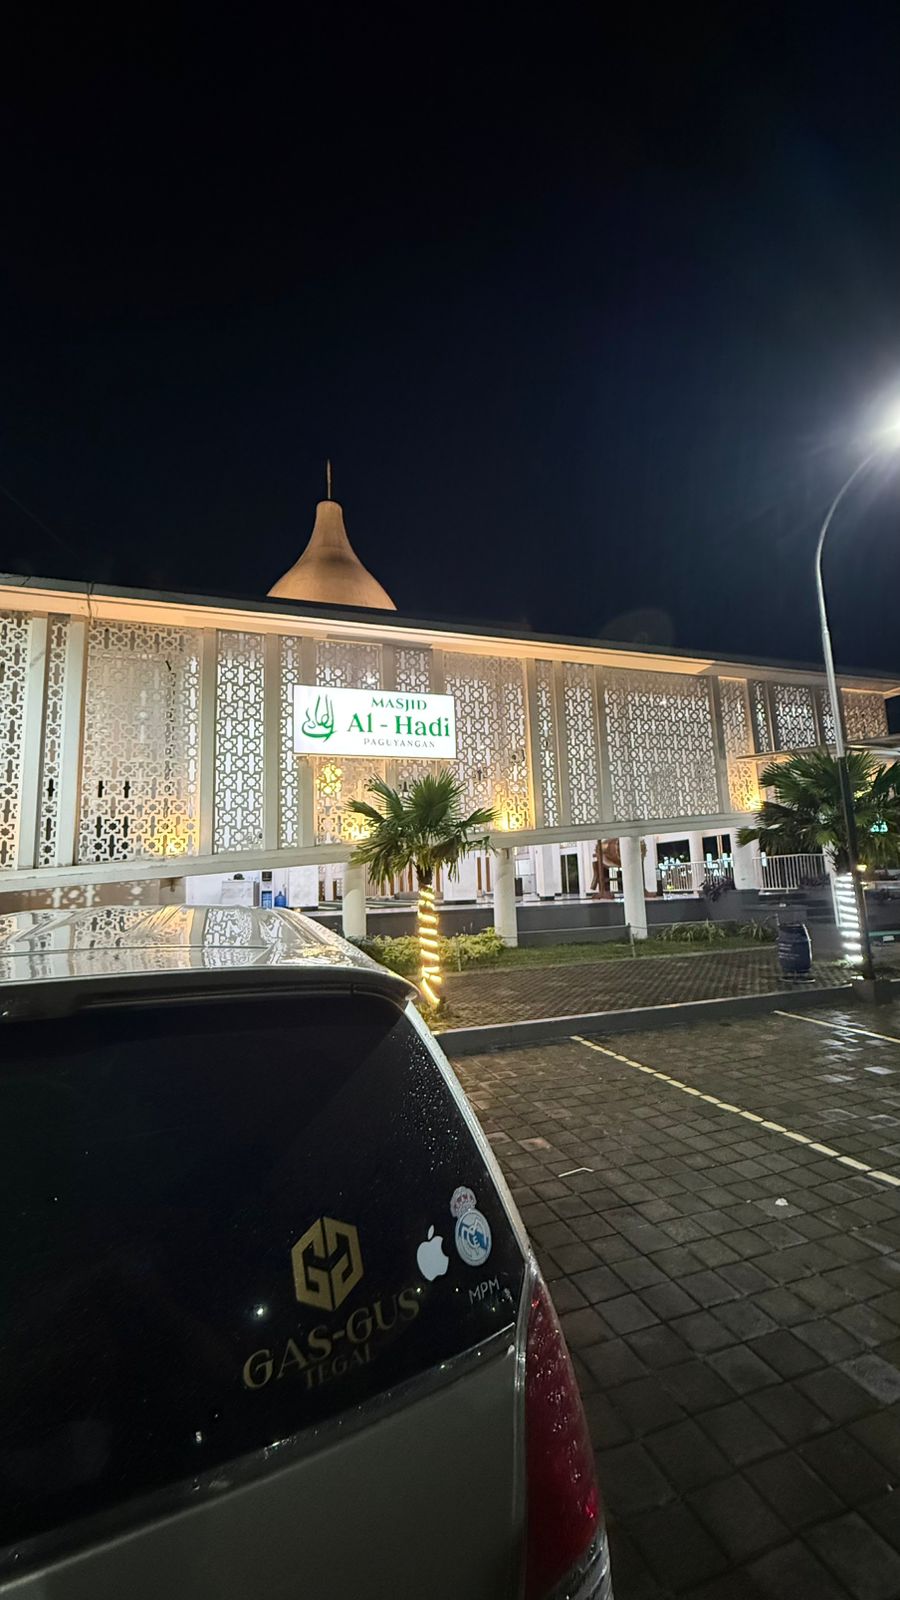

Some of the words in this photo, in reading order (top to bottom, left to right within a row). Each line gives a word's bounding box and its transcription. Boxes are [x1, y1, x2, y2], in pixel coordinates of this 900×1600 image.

[370, 697, 428, 712] MASJID
[347, 712, 374, 733] Al
[395, 715, 450, 737] Hadi
[363, 737, 436, 749] PAGUYANGAN
[468, 1275, 500, 1304] MPM
[242, 1287, 420, 1389] GAS-GUS
